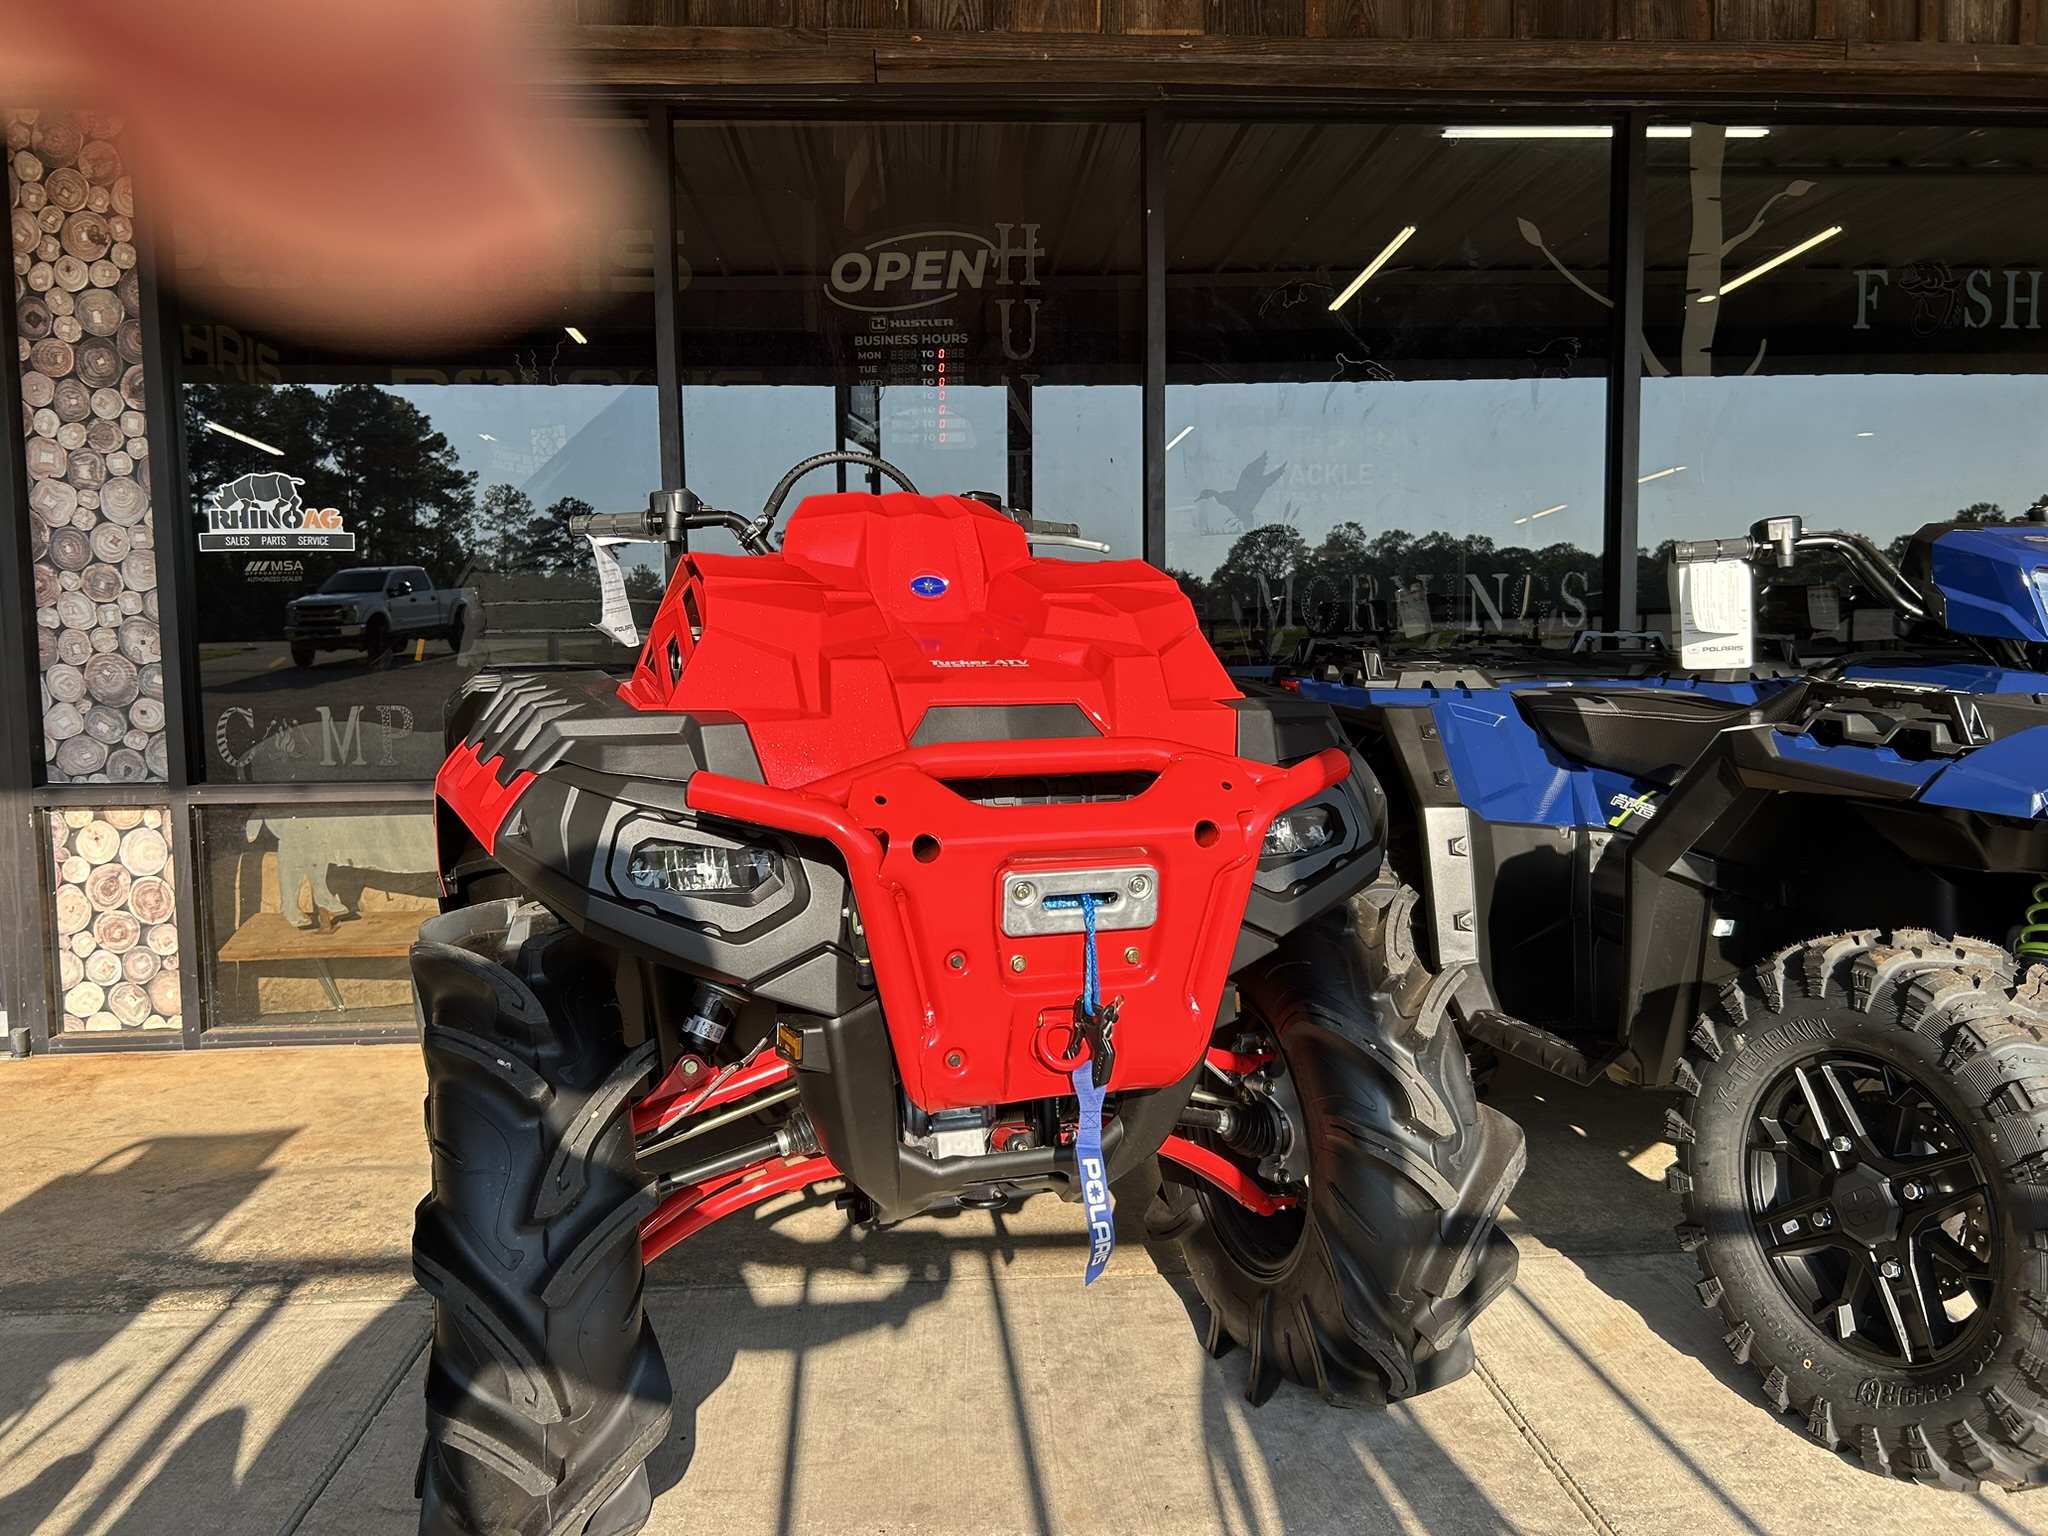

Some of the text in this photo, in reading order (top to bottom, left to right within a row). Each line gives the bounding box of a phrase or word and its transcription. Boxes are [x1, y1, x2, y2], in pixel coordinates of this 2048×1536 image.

[830, 249, 988, 293] OPEN
[890, 319, 954, 328] HUSTLER
[854, 333, 969, 347] BUSINESS HOURS
[858, 351, 882, 360] MON
[921, 350, 935, 358] TO
[859, 365, 878, 374] TUE
[921, 364, 935, 372] TO
[860, 379, 883, 388] WED
[922, 379, 935, 387] TO
[226, 536, 329, 546] SALES PARTS SERVICE
[271, 560, 304, 571] MSA
[1082, 1158, 1112, 1266] POLARIS
